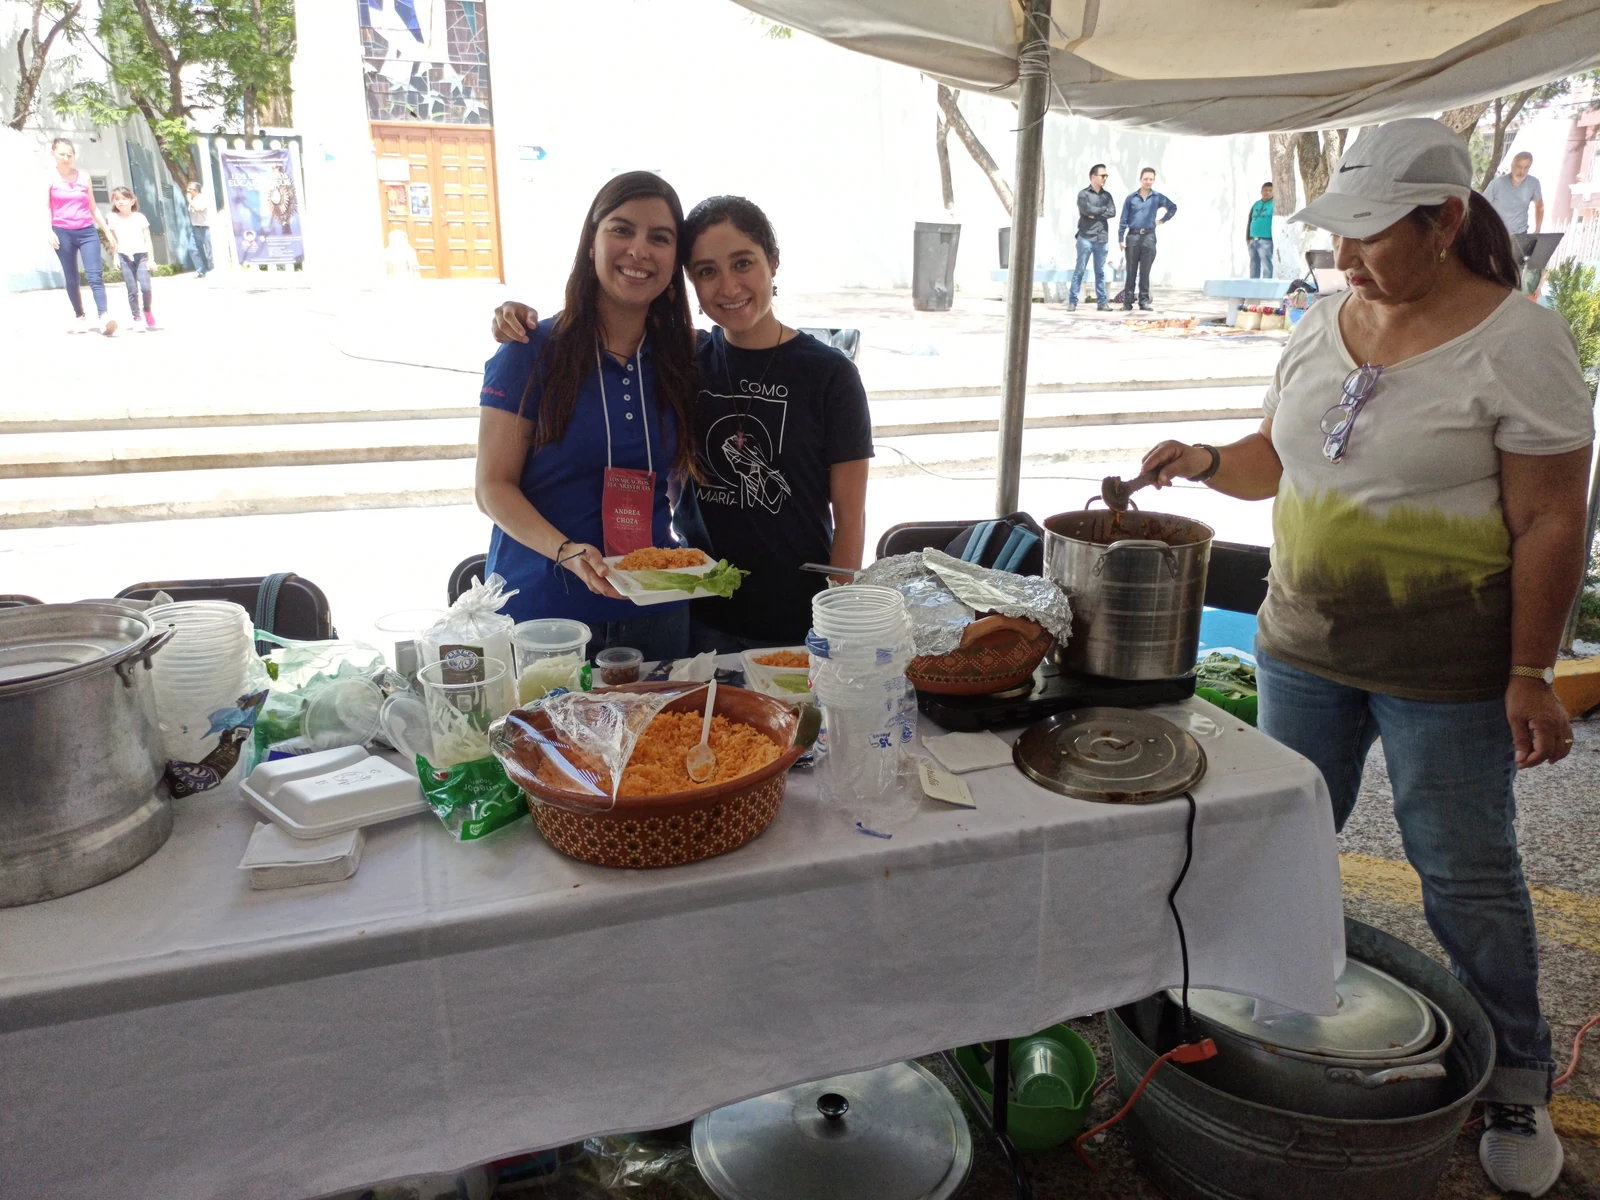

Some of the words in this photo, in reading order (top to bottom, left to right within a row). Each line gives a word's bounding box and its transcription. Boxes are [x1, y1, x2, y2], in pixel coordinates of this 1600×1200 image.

[740, 379, 788, 398] COMO
[614, 508, 641, 516] ANDREA
[616, 517, 638, 525] CHOZA
